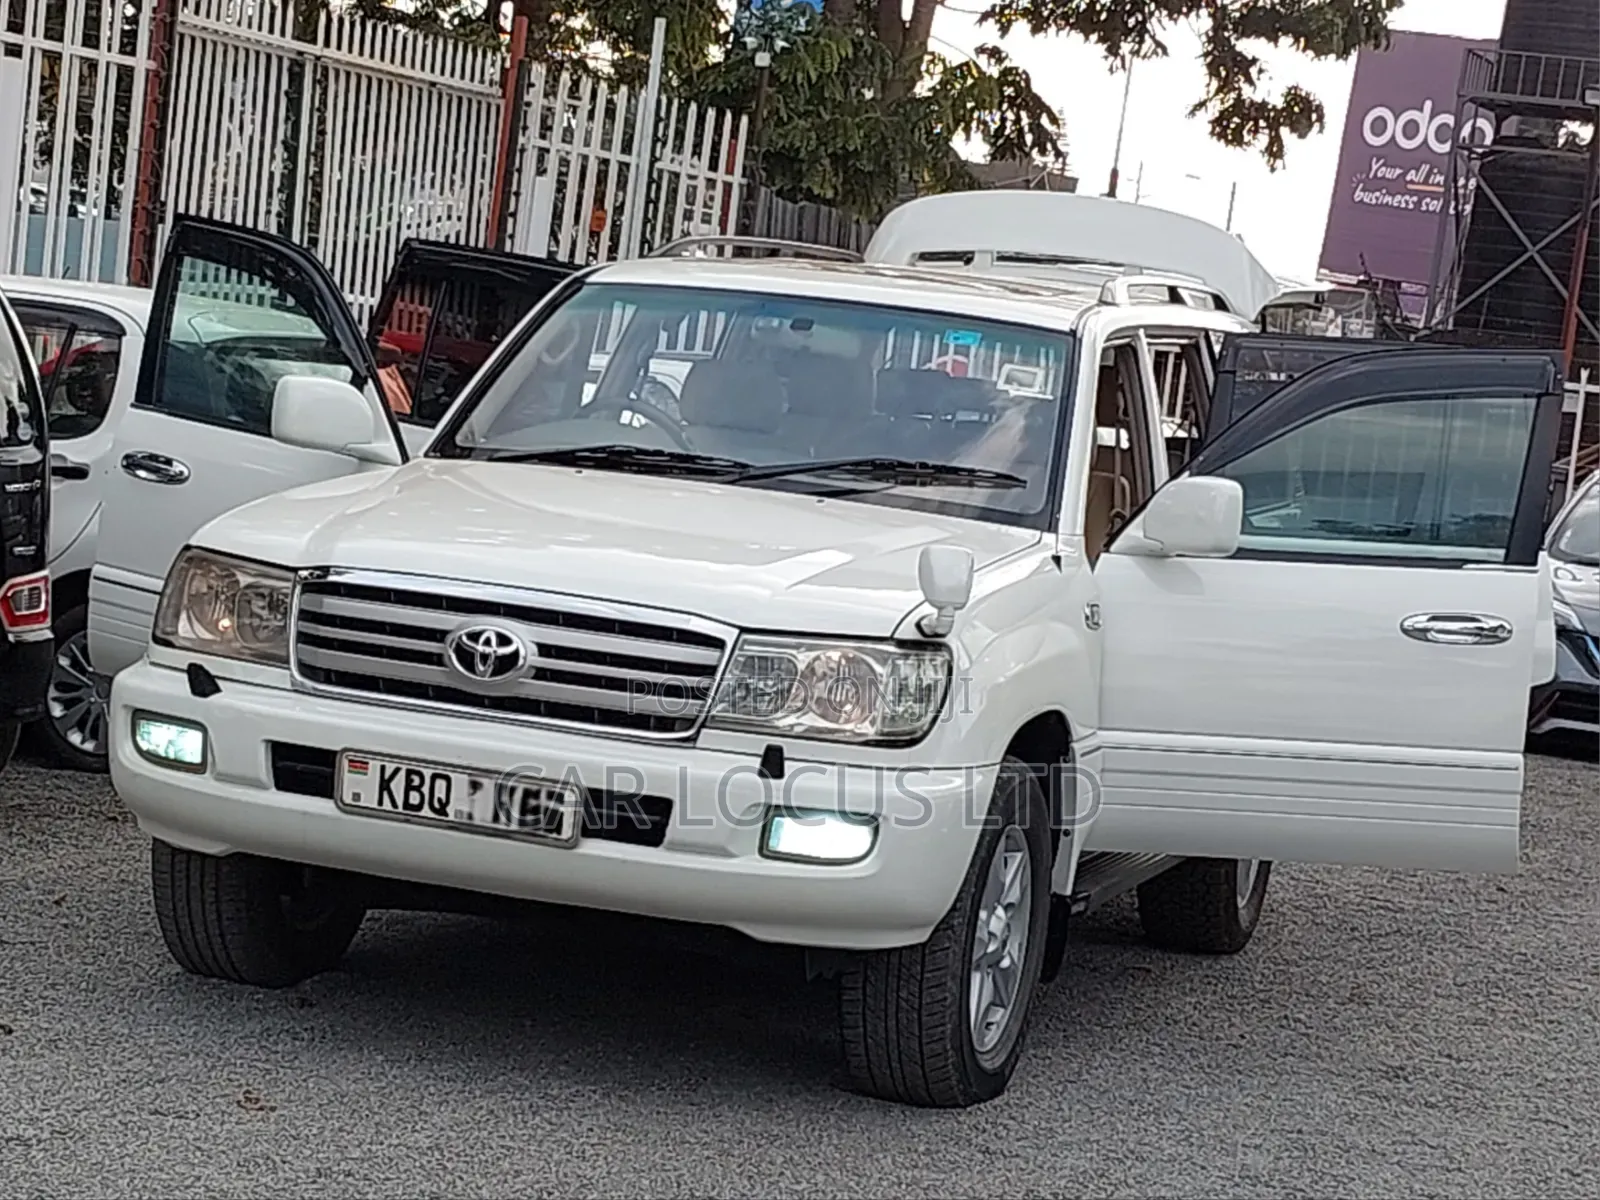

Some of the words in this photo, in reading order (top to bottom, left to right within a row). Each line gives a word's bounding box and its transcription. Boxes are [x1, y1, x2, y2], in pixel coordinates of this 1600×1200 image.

[1368, 156, 1403, 180] Your
[1405, 163, 1430, 184] all
[1429, 167, 1445, 186] in
[1353, 183, 1418, 210] business
[376, 763, 452, 817] KBQ
